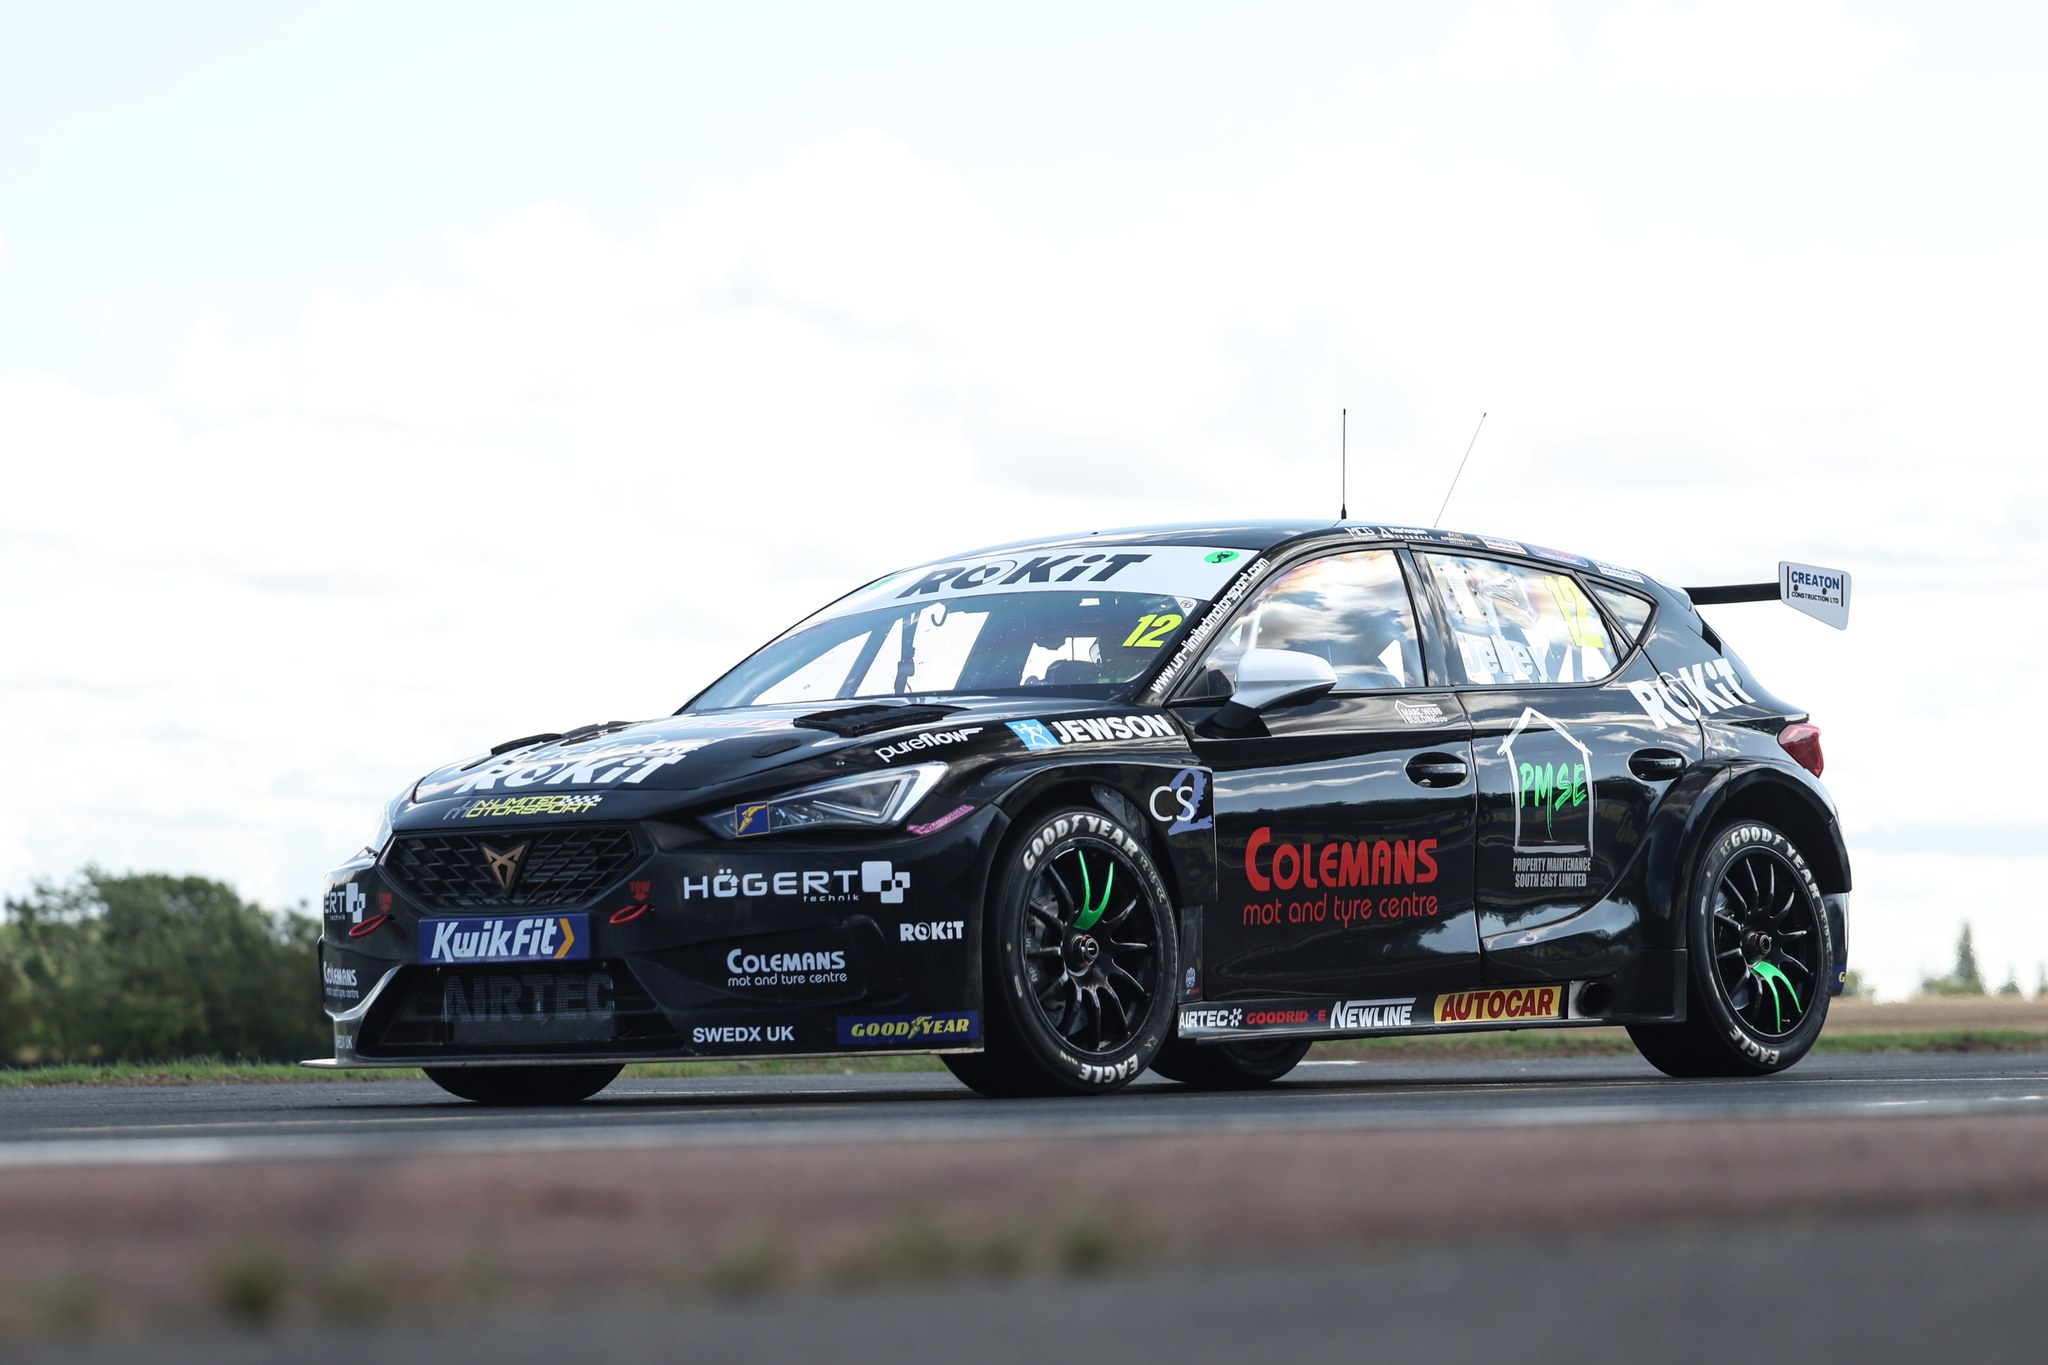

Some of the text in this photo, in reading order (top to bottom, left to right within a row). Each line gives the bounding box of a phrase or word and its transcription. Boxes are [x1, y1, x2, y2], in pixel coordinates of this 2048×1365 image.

[1791, 571, 1839, 590] CREATON
[1791, 591, 1839, 604] CONSTRUCTION LTD
[1121, 614, 1182, 648] 12
[1151, 557, 1270, 694] www.un-limitedmotorsport.com
[1051, 714, 1176, 744] JEWSON
[875, 727, 983, 763] pureflow
[1520, 762, 1587, 840] PMSE
[1513, 857, 1591, 872] PROPERTY MAINTENANCE
[684, 868, 858, 899] HÖGERT
[1515, 873, 1587, 887] SOUTH EAST LIMITED
[803, 894, 859, 903] technik
[1243, 892, 1438, 929] mot and tyre centre
[728, 975, 751, 987] mot
[754, 973, 778, 986] and
[809, 971, 848, 983] centre
[440, 972, 615, 1022] AIRTEC
[1441, 988, 1554, 1022] AUTOCAR
[1178, 1010, 1229, 1029] AIRTEC
[1331, 998, 1416, 1028] NEWLINE
[693, 1026, 795, 1043] SWEDX UK
[1729, 1025, 1780, 1065] EAGLE
[1078, 1053, 1138, 1083] EAGLE
